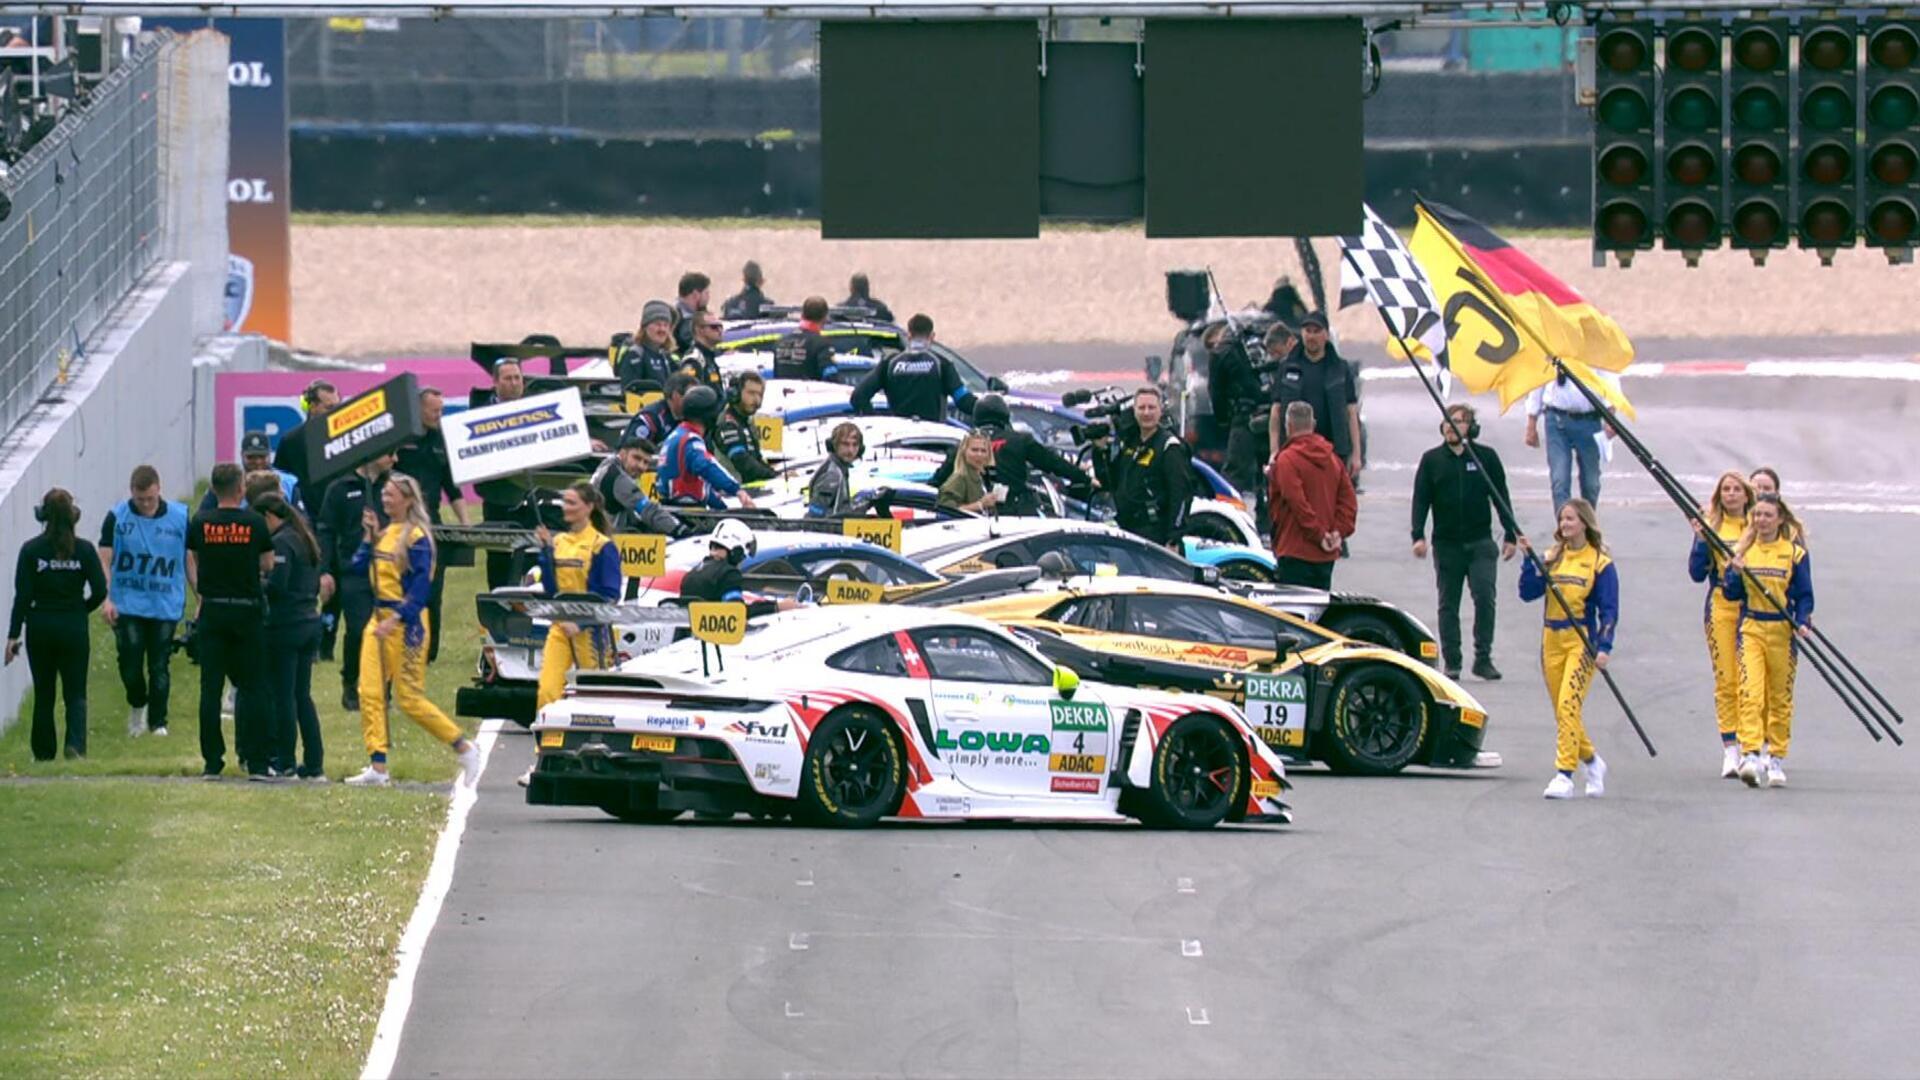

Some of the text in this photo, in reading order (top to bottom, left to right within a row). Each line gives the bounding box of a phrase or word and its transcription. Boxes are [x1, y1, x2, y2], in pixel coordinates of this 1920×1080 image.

[473, 409, 555, 435] RAVENOL
[458, 423, 579, 460] CHAMPIONSHIP LEADER
[116, 551, 176, 578] DTM
[619, 547, 656, 564] ADAC
[836, 587, 872, 601] ADAC
[699, 615, 737, 633] ADAC
[1247, 679, 1304, 699] DEKRA
[647, 715, 689, 727] Repanel
[1052, 706, 1106, 726] DEKRA
[1264, 704, 1288, 726] 19
[936, 728, 1050, 755] LOWA
[1073, 732, 1084, 754] 4
[1256, 727, 1291, 744] ADAC
[948, 752, 988, 767] simply
[1059, 755, 1094, 772] ADAC
